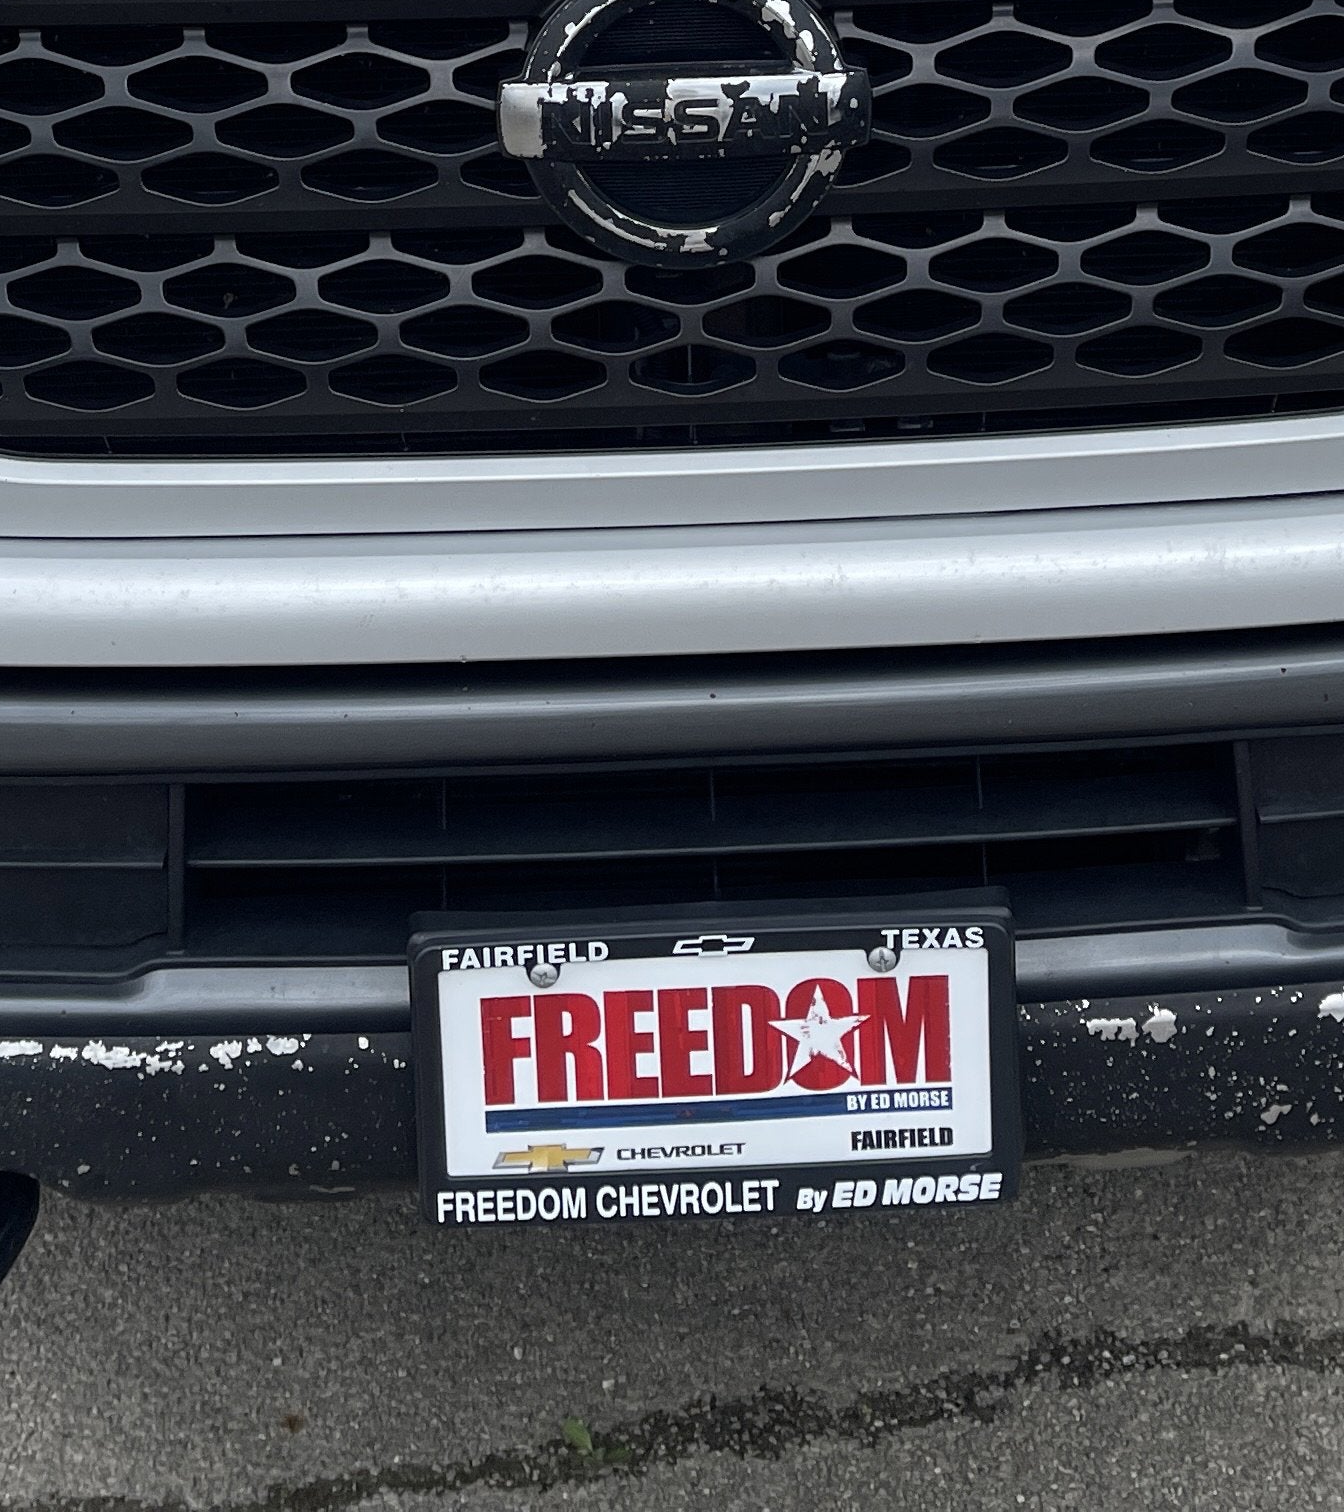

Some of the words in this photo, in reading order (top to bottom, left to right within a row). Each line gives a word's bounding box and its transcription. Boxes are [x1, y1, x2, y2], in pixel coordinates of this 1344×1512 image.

[881, 927, 984, 950] TEXAS
[441, 941, 609, 971] FAIRFIELD
[479, 975, 952, 1106] FREEDOM
[847, 1096, 867, 1112] BY
[870, 1094, 890, 1110] ED
[894, 1091, 949, 1109] MORSE
[617, 1142, 745, 1161] CHEVROLET
[851, 1126, 954, 1152] FAIRFIELD
[437, 1187, 587, 1223] FREEDOM
[596, 1180, 779, 1218] CHEVROLET
[797, 1187, 827, 1212] By
[832, 1179, 877, 1208] ED
[882, 1173, 1002, 1205] MORSE
